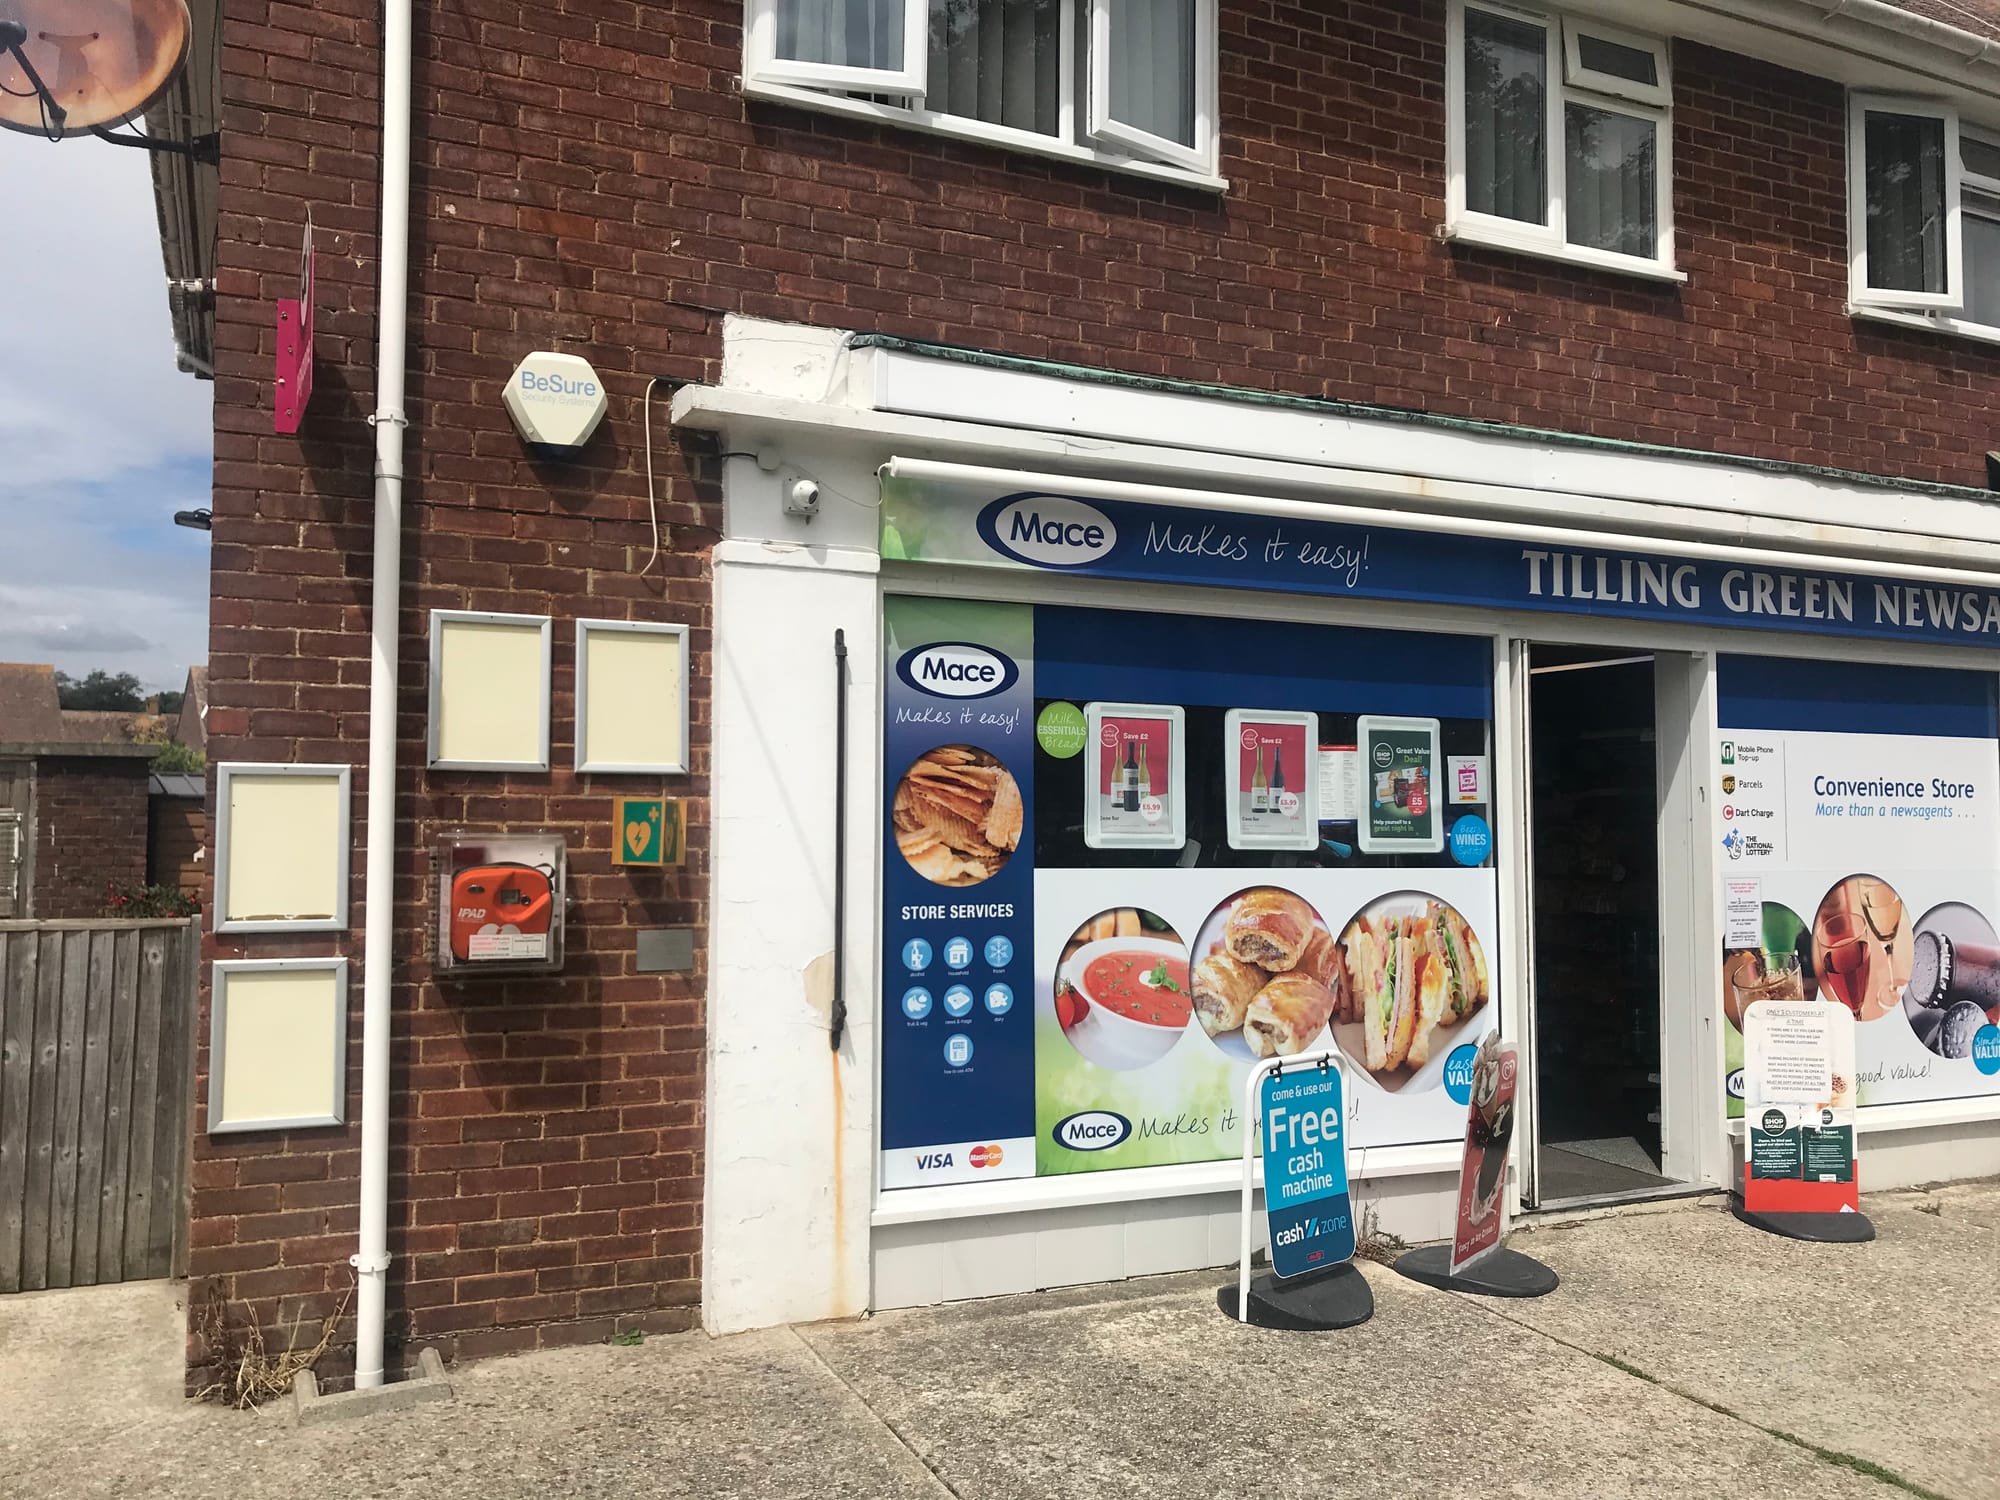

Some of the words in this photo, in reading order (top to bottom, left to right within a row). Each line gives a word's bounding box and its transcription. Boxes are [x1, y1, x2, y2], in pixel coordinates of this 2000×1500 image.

[521, 370, 596, 396] BeSure
[521, 391, 555, 404] Security
[1010, 510, 1105, 549] Mace
[1143, 520, 1248, 560] Makes
[1297, 534, 1371, 588] easy!
[1521, 549, 1701, 609] TILLING
[1720, 569, 1854, 622] GREEN
[922, 656, 996, 682] Mace
[895, 706, 952, 724] Makes
[960, 707, 974, 724] it
[980, 707, 1020, 734] easy!
[1047, 711, 1073, 725] Milk
[1038, 725, 1087, 736] ESSENTIALS
[1123, 732, 1139, 740] Save
[1045, 736, 1081, 749] Bread
[1737, 745, 1755, 753] Mobile
[1738, 754, 1760, 762] Top-up
[1739, 780, 1763, 789] Parcels
[1814, 775, 1925, 798] Convenience
[1932, 778, 1975, 799] Store
[1735, 809, 1750, 817] Dart
[1751, 809, 1774, 818] Charge
[1815, 803, 1844, 817] More
[1849, 804, 1874, 817] than
[1879, 805, 1886, 817] a
[1891, 805, 1953, 820] newsagents
[1455, 834, 1487, 846] WINES
[458, 908, 486, 918] IPAD
[901, 905, 946, 920] STORE
[950, 903, 1014, 919] SERVICES
[1890, 1059, 1931, 1080] value!
[1272, 1091, 1294, 1101] come
[1295, 1085, 1302, 1097] &
[1304, 1087, 1318, 1095] use
[1319, 1082, 1333, 1093] our
[1069, 1122, 1118, 1140] Mace
[1138, 1113, 1209, 1140] Makes
[1221, 1109, 1238, 1131] it
[1269, 1107, 1339, 1152] Free
[916, 1152, 953, 1170] VISA
[970, 1151, 1003, 1162] MasterCard
[1288, 1147, 1324, 1175] cash
[1282, 1173, 1334, 1199] machine
[1276, 1222, 1305, 1246] cash
[1321, 1215, 1347, 1234] zone
